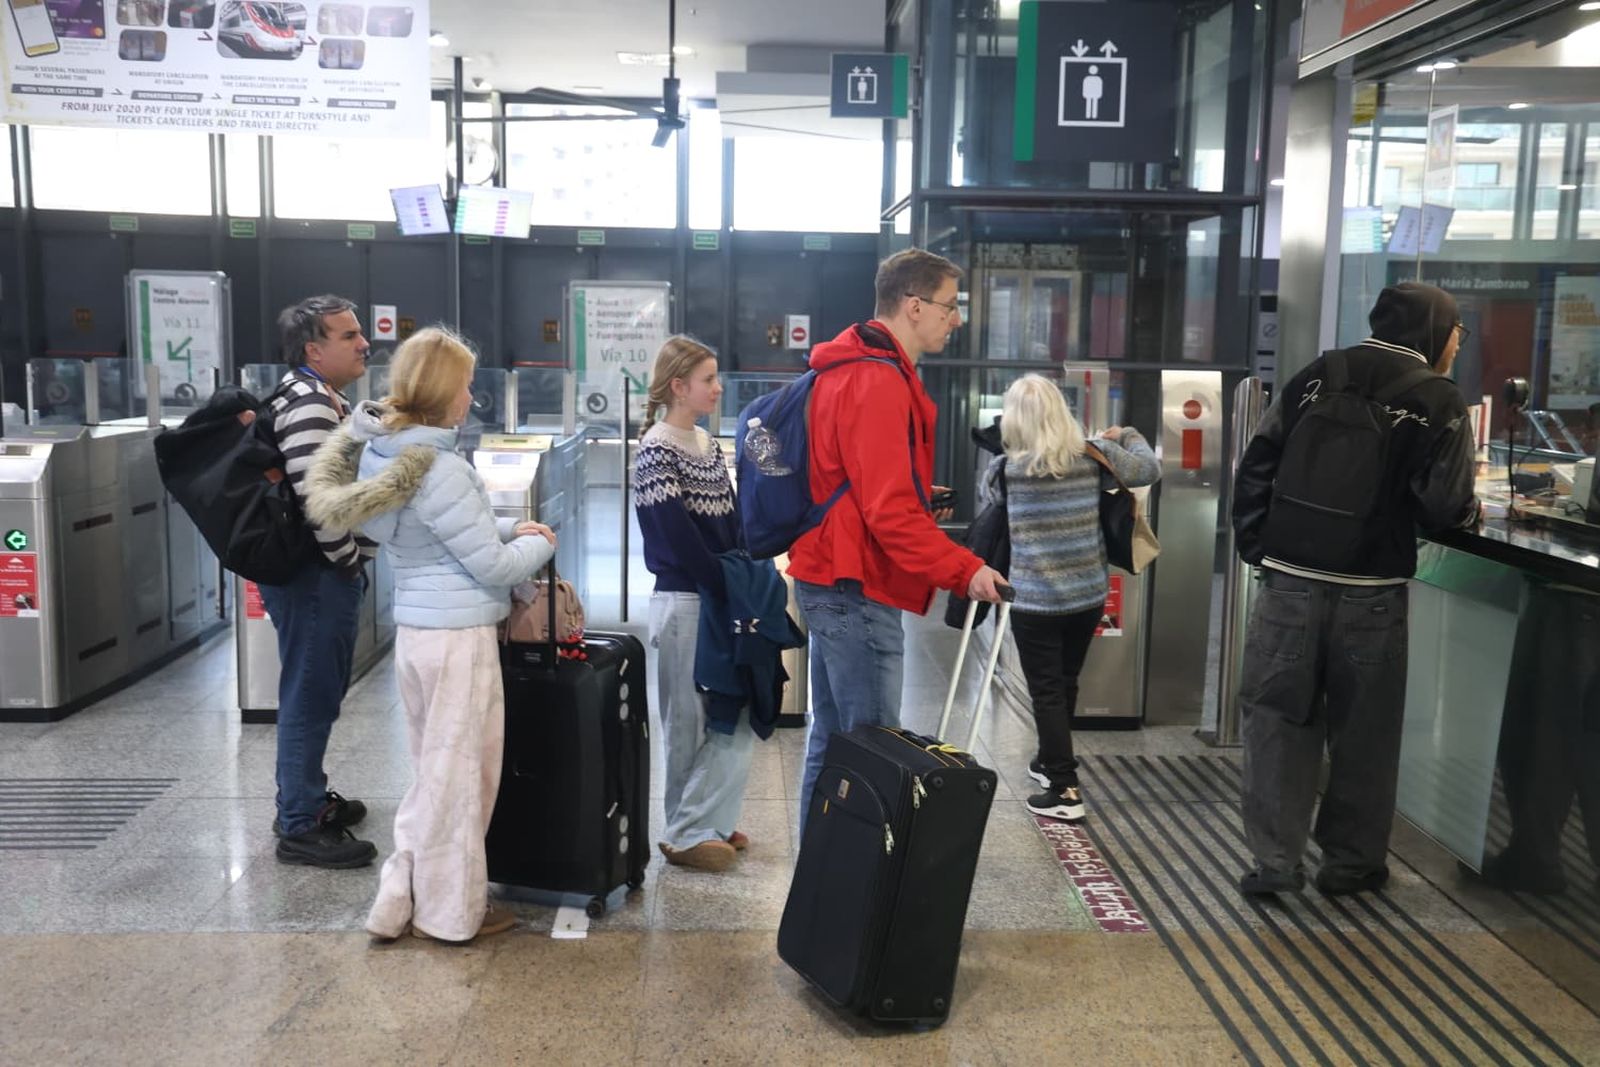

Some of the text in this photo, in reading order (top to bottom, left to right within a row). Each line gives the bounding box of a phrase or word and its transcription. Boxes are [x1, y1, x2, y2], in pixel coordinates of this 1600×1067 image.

[61, 102, 371, 122] FROM JULY 2020 PAY FOR YOUR SINGLE TICKET AT TURNSTYLE AND
[116, 115, 153, 125] TICKETS
[156, 117, 214, 127] CANCELLERS
[216, 118, 238, 128] AND
[240, 119, 273, 129] TRAVEL
[1441, 278, 1471, 289] María
[1474, 279, 1529, 289] Zambrano
[187, 317, 200, 329] 11
[600, 348, 647, 362] Vía 10
